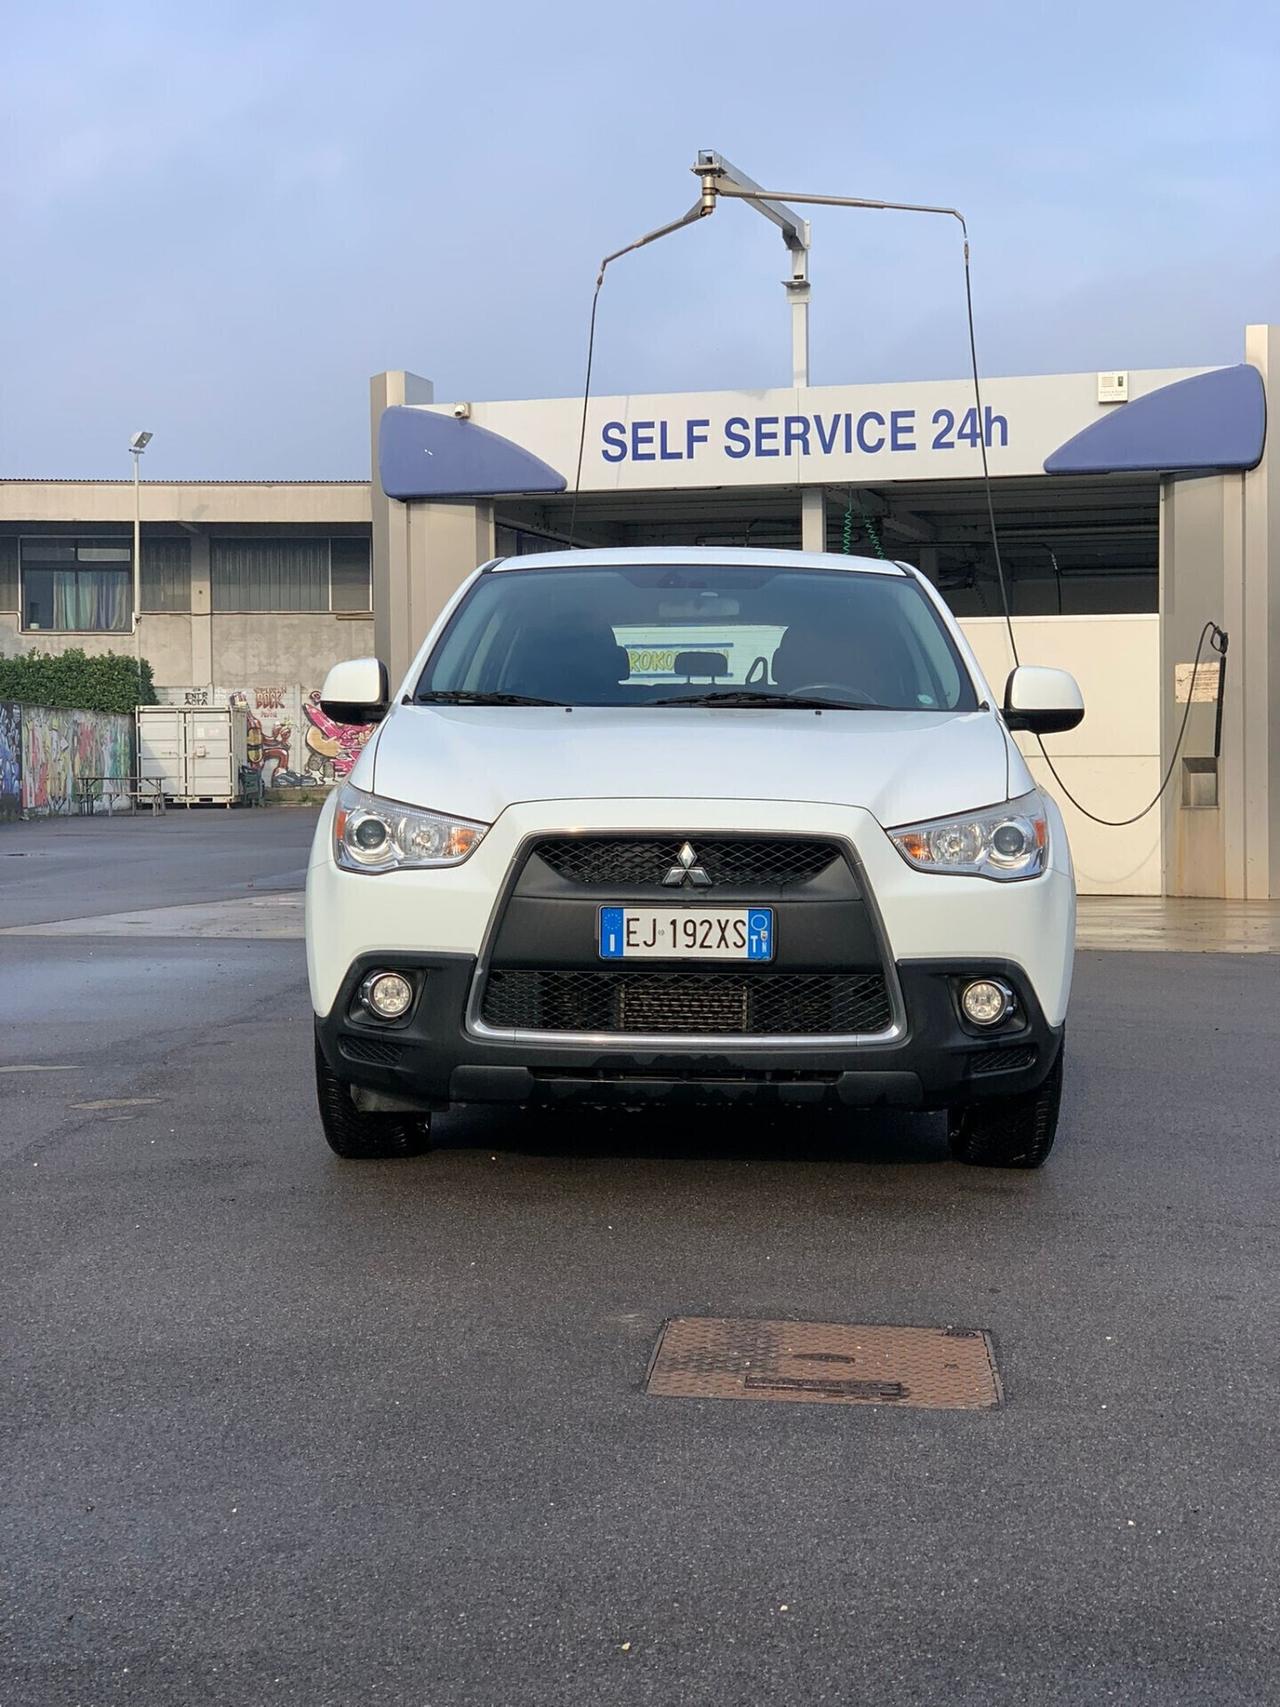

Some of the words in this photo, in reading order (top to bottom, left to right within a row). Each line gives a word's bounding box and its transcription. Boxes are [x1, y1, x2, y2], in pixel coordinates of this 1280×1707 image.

[601, 419, 711, 463] SELF
[723, 410, 917, 459] SERVICE
[931, 406, 1008, 449] 24h
[626, 918, 657, 948] EJ
[669, 918, 747, 949] 192XS
